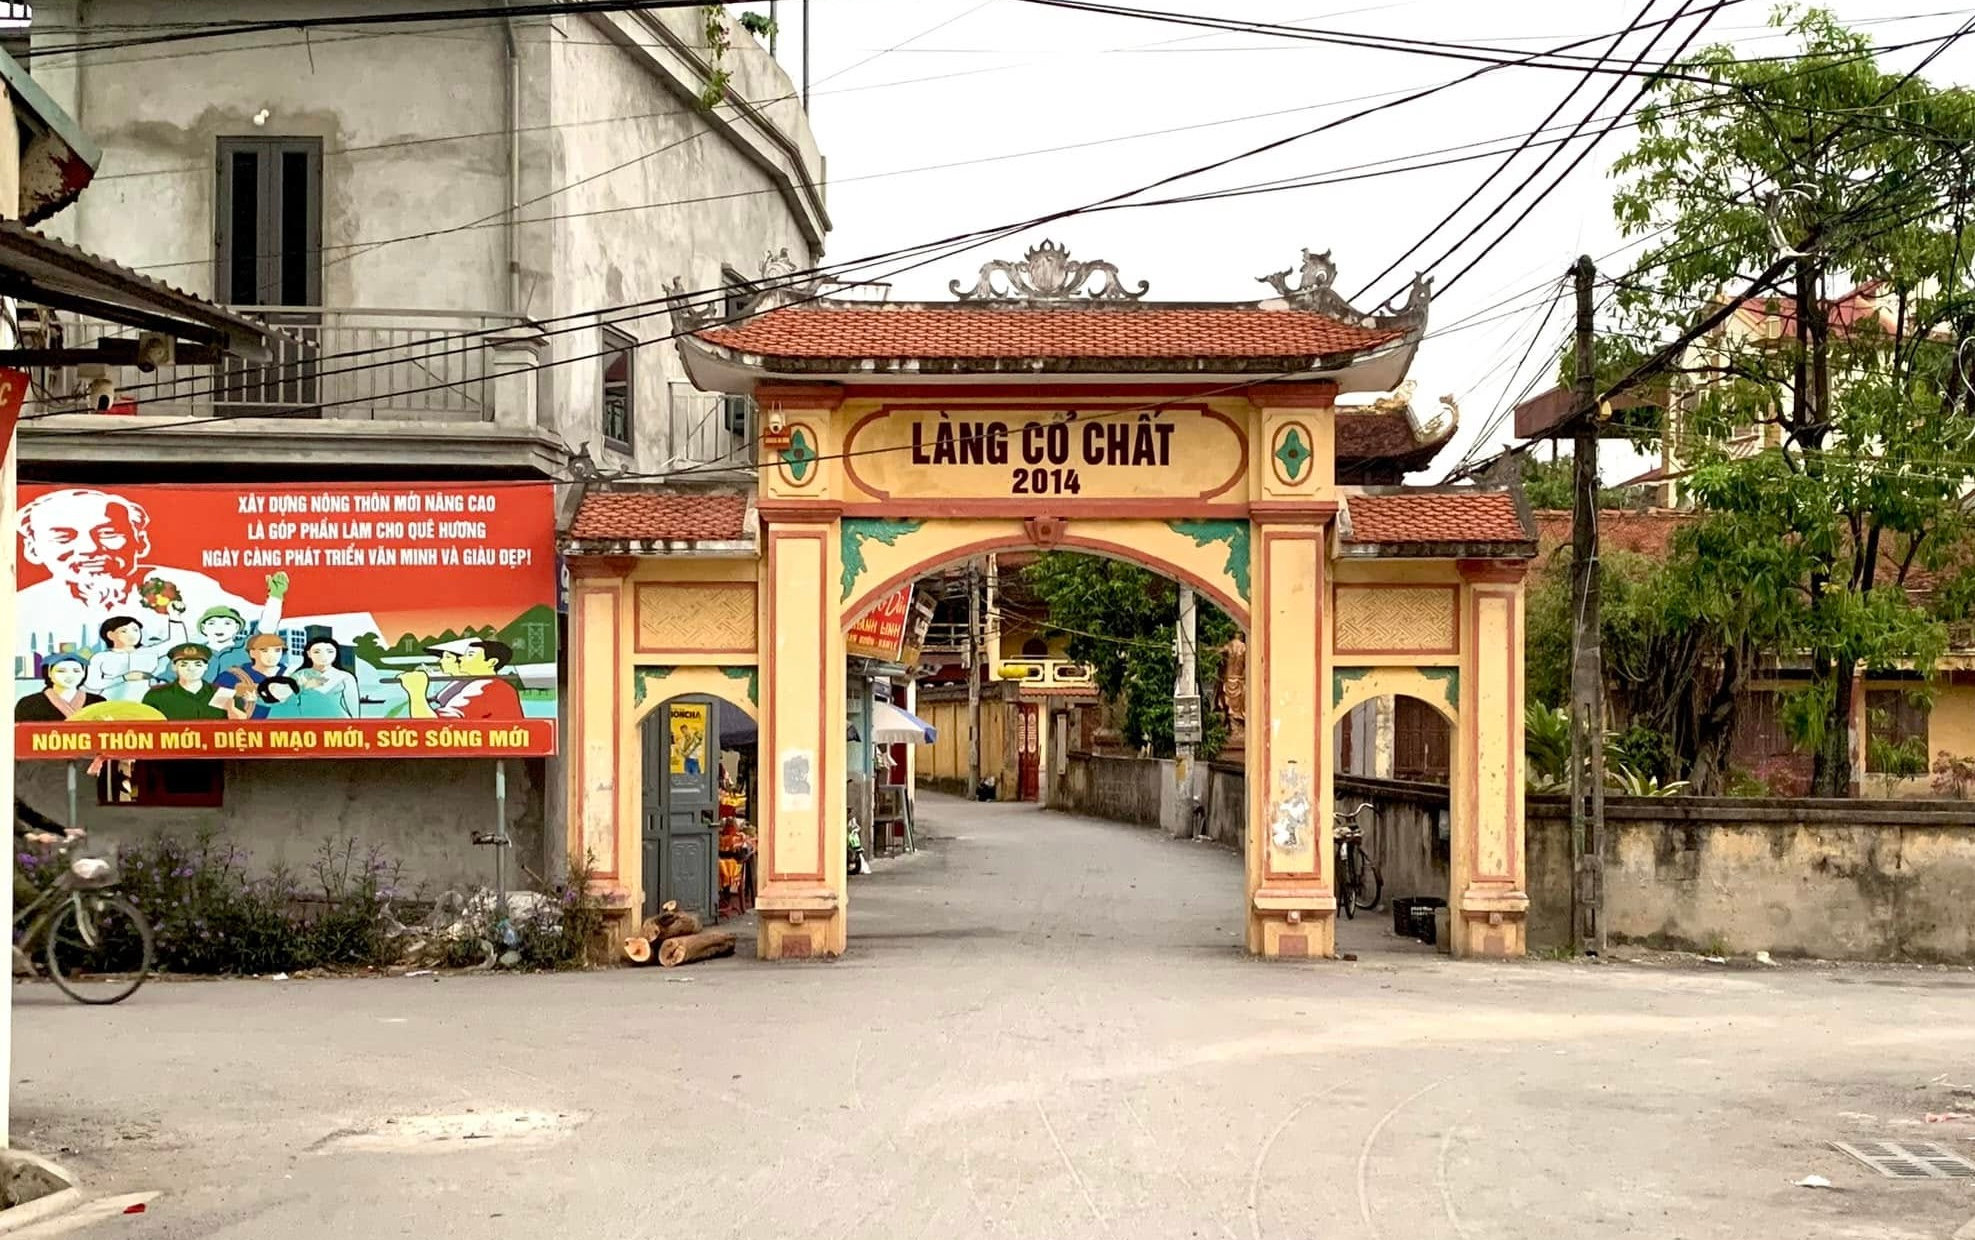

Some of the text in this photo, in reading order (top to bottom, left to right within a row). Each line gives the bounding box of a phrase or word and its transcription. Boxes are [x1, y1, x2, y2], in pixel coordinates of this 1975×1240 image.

[912, 410, 1175, 466] LÀNG CỔ CHẤT
[1012, 468, 1081, 494] 2014
[238, 490, 496, 517] XÂY DỰNG NÔNG THÔN MỚI NÂNG CAO
[247, 519, 265, 540] LÀ
[268, 519, 297, 540] GÓP
[342, 518, 373, 540] LÀM
[376, 521, 405, 540] CHO
[408, 518, 435, 541] QUÊ
[438, 520, 487, 540] HƯƠNG
[202, 543, 532, 569] NGÀY CÀNG PHÁT TRIỂN VĂN MINH VÀ GIÀU ĐẸP!
[32, 725, 530, 752] NÔNG THÔN MỚI, DIỆN MẠO MỚI, SỨC SỐNG MỚI
